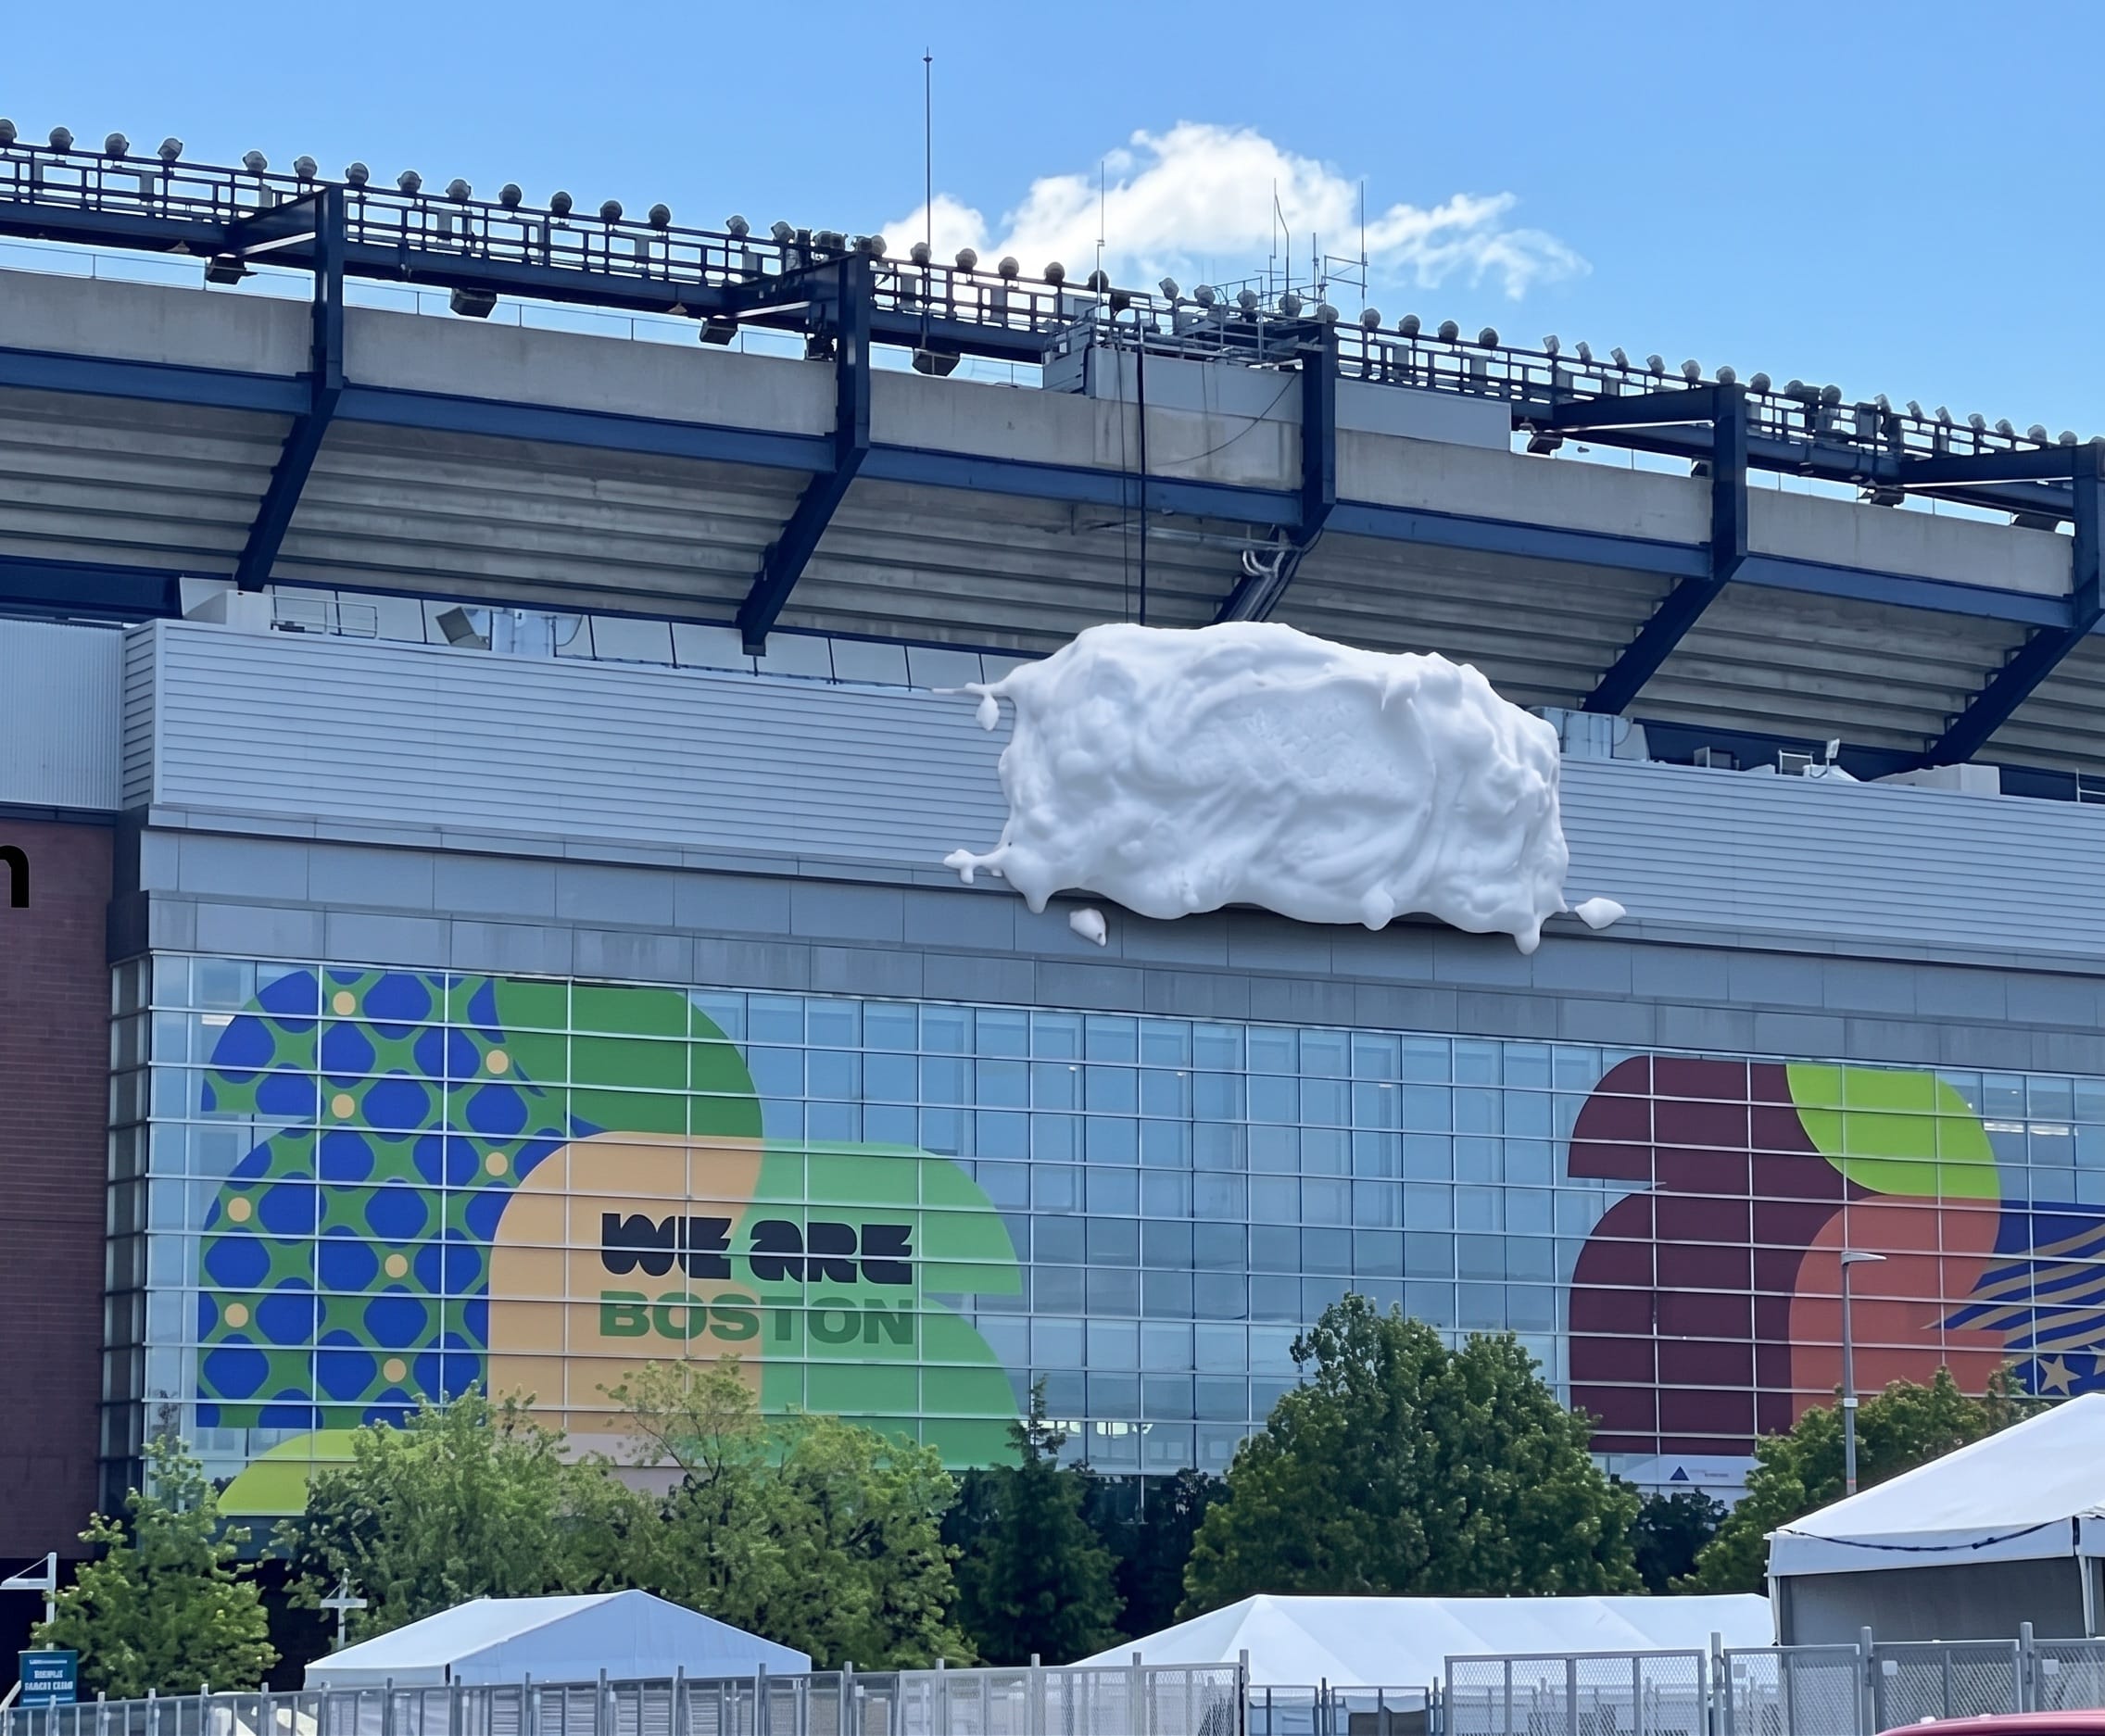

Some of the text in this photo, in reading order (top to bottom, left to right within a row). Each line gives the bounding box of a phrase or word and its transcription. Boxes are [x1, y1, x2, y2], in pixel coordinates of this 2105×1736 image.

[601, 1213, 913, 1284] WE ARE
[599, 1289, 914, 1345] BOSTON
